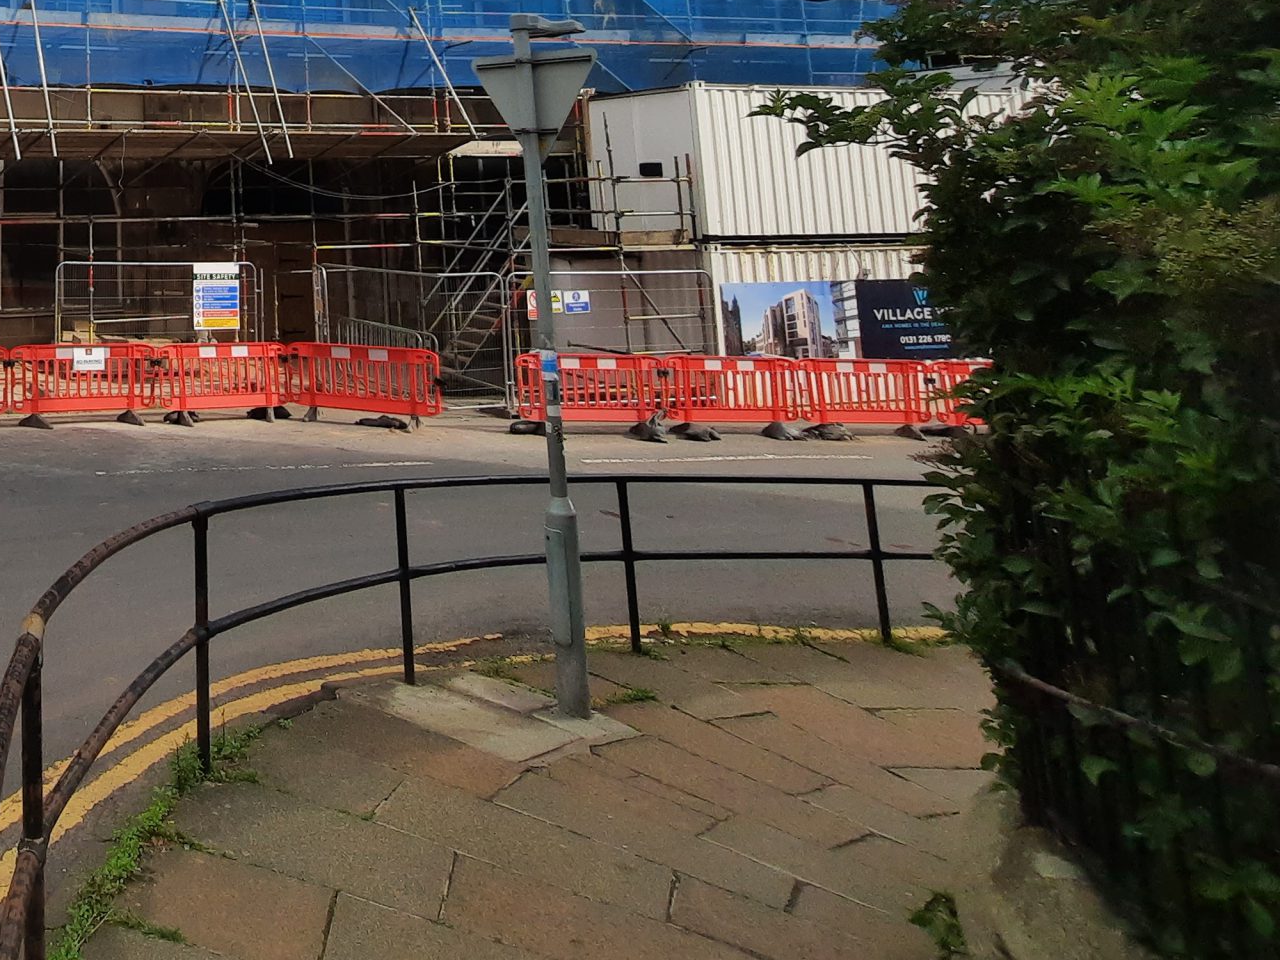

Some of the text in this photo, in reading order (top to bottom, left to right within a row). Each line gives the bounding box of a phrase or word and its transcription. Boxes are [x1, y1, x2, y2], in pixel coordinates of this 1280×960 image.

[873, 307, 933, 320] VILLAGE
[900, 335, 917, 343] 0131
[918, 335, 933, 343] 226
